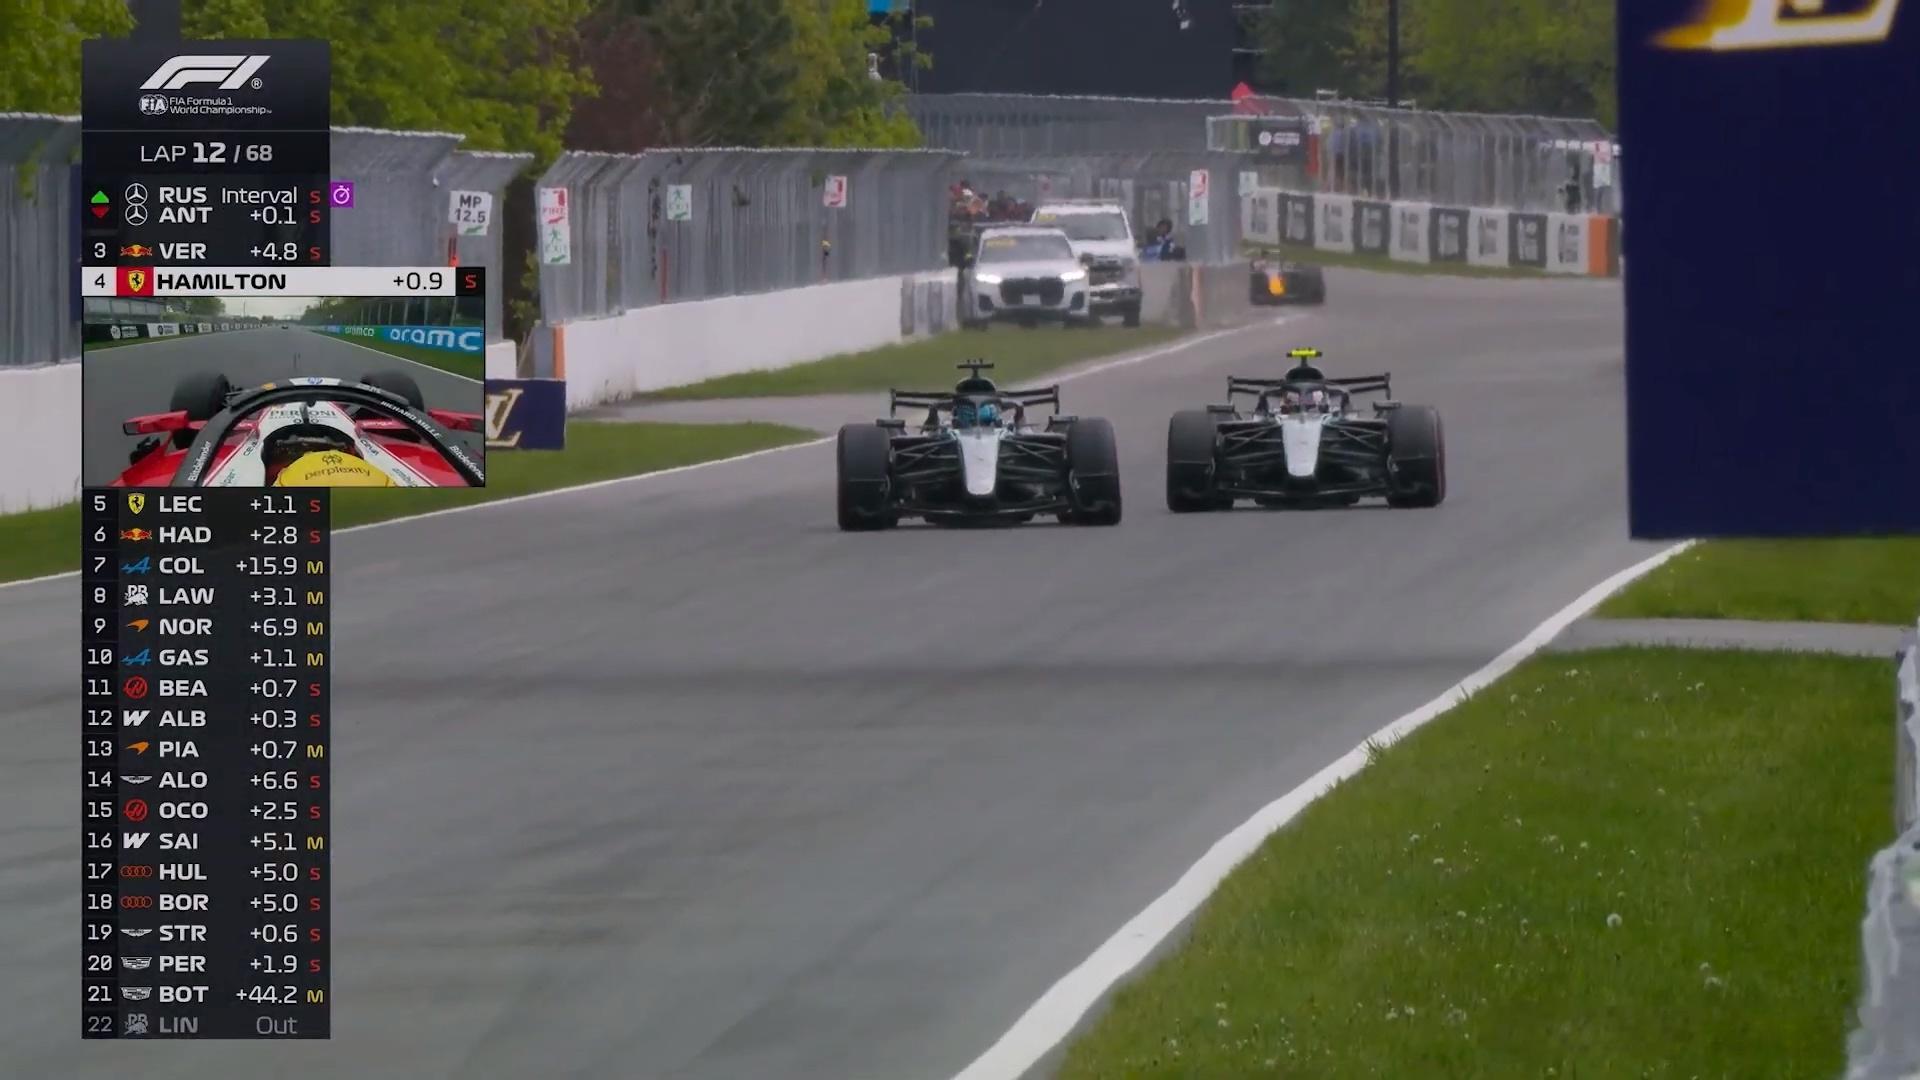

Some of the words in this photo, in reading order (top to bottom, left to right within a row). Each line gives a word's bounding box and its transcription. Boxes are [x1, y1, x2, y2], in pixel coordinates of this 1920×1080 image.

[460, 194, 482, 208] MP
[455, 208, 486, 223] 12.5
[304, 466, 371, 481] perplexity
